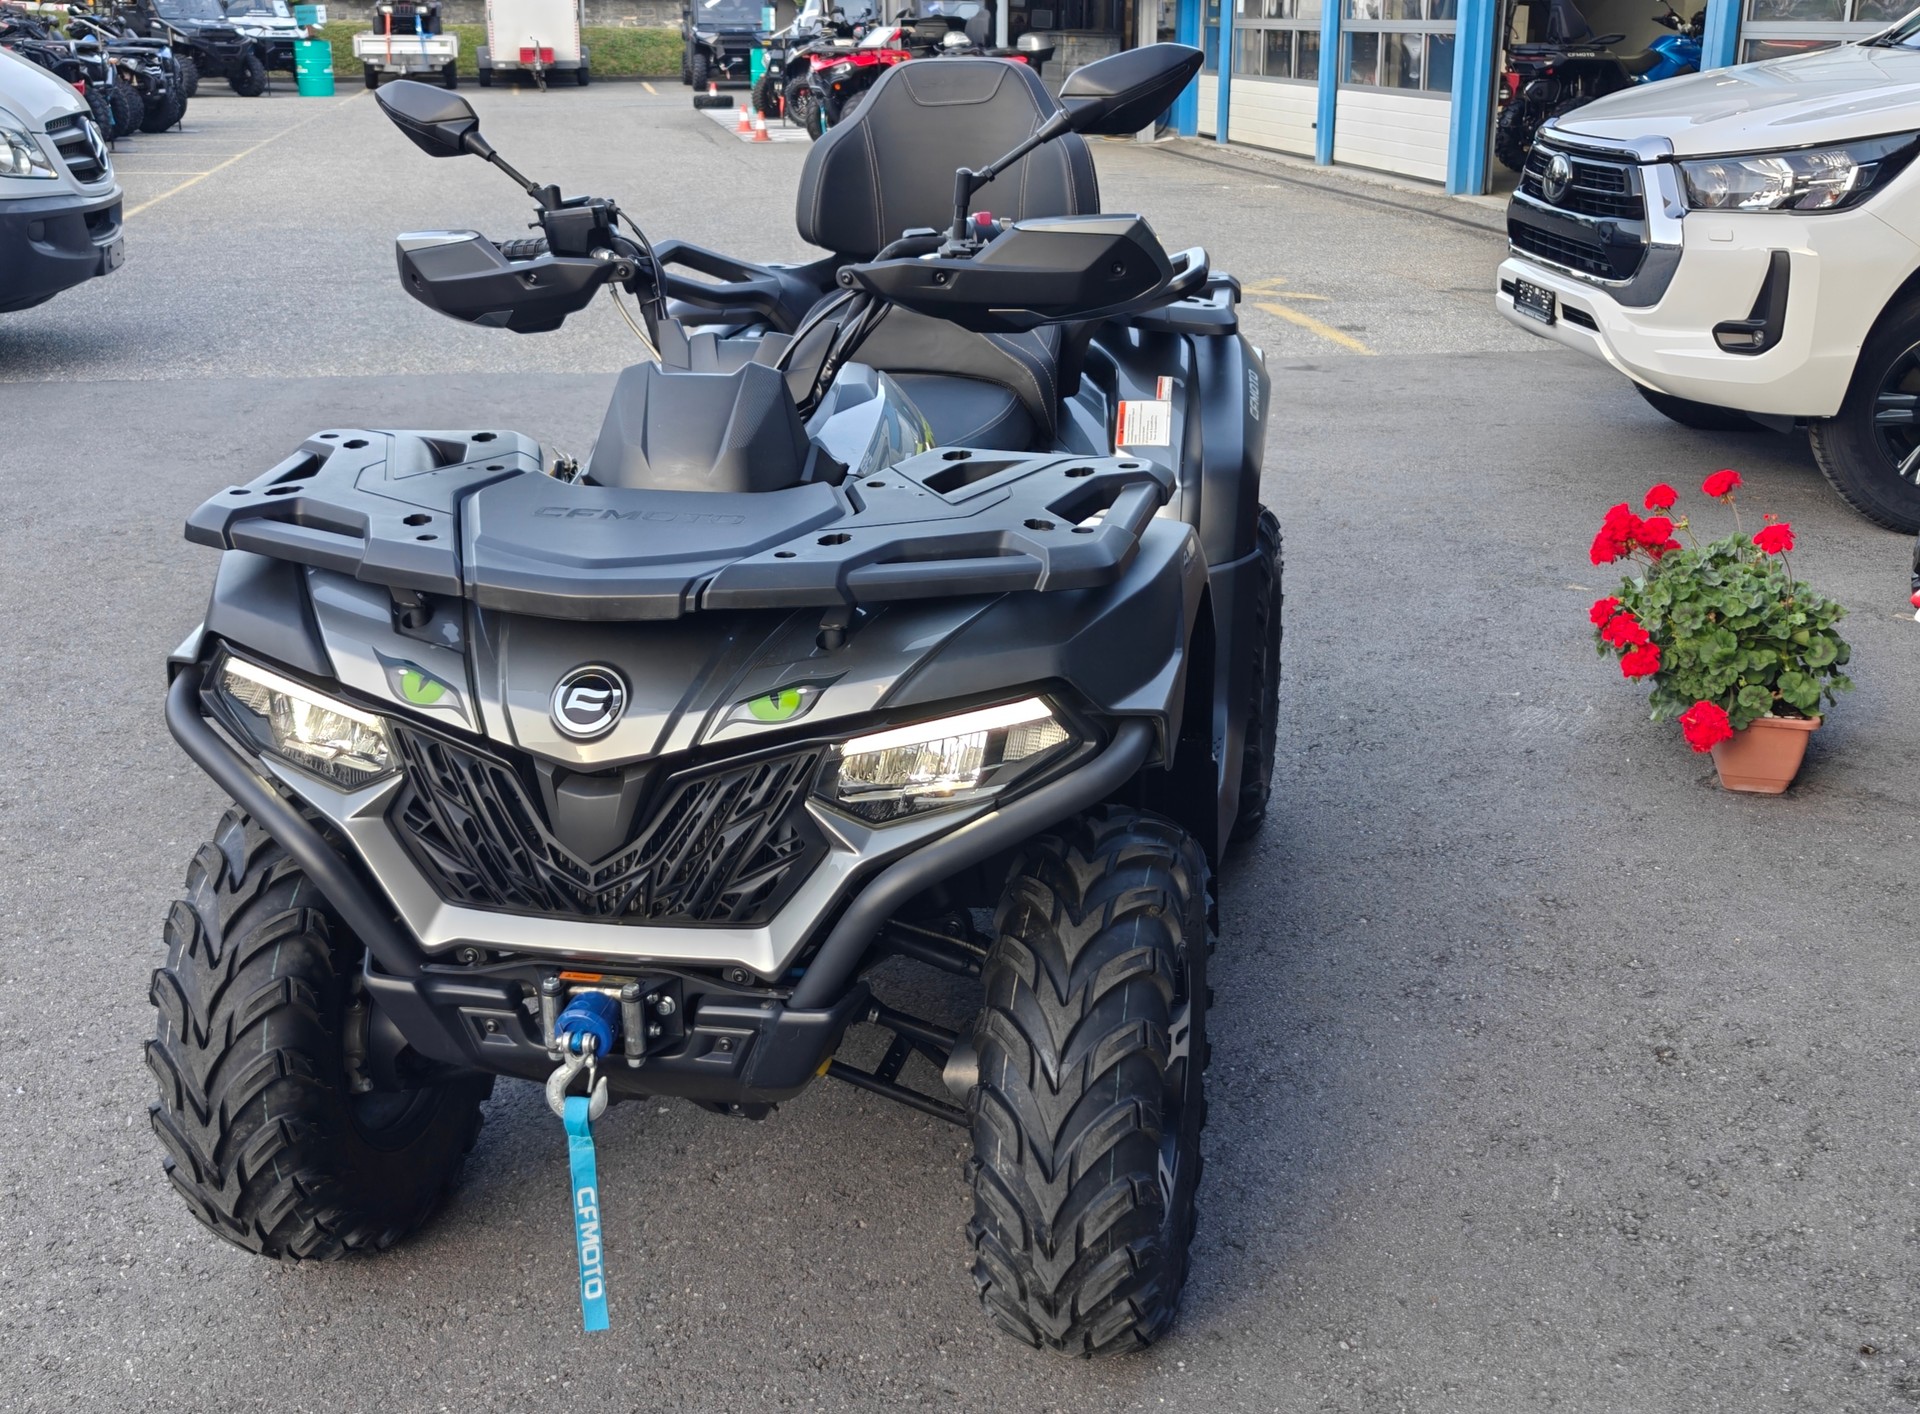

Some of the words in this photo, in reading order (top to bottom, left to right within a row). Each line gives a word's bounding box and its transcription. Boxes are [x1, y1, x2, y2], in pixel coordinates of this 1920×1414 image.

[1248, 368, 1259, 421] CFMOTO
[534, 505, 746, 525] CFMOTO
[577, 1187, 602, 1300] CFMOTO
